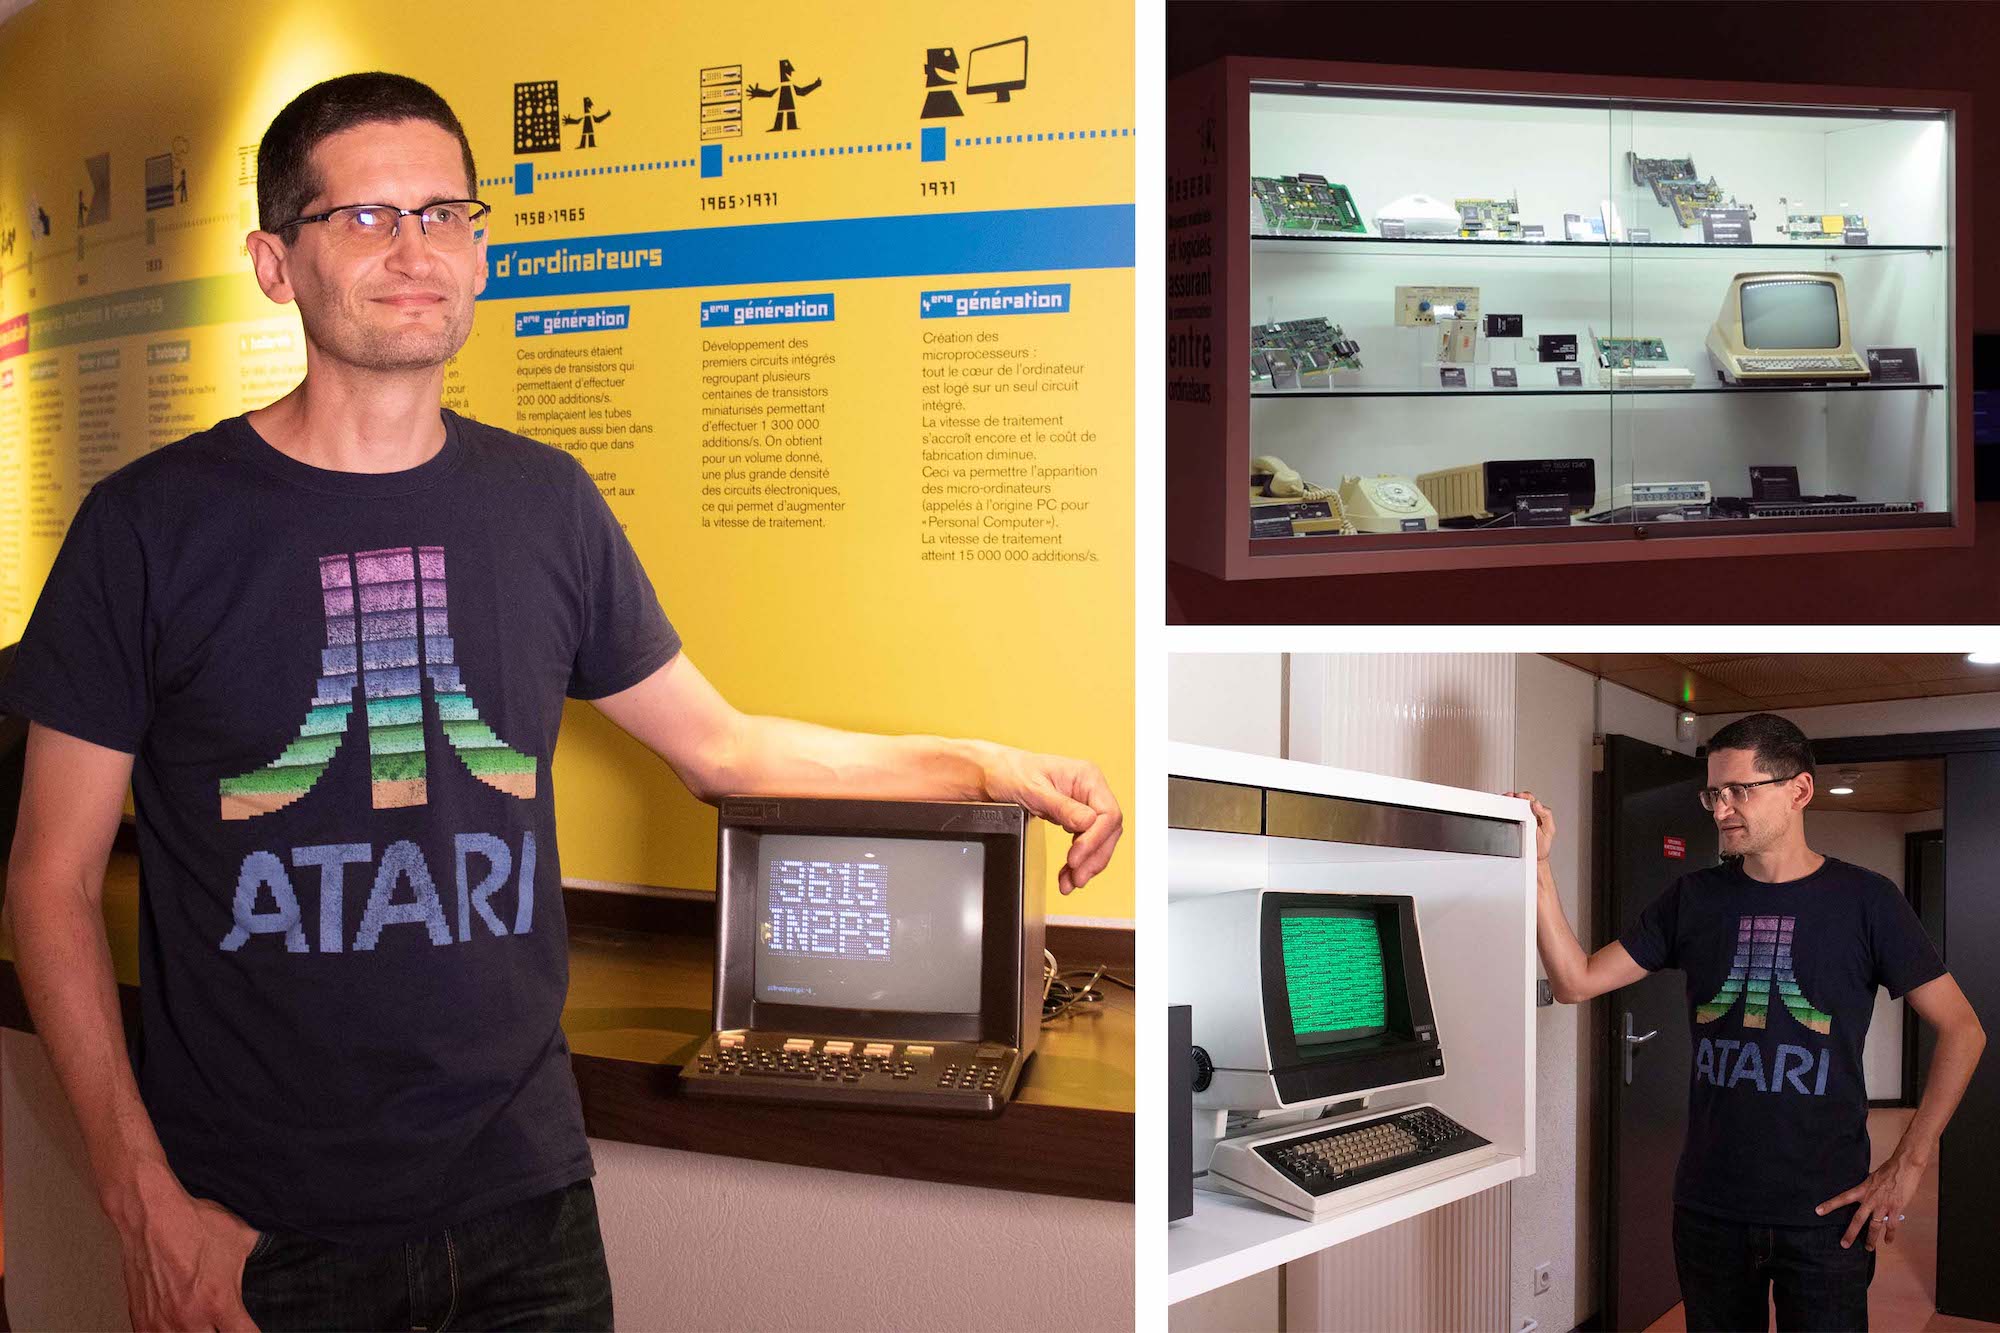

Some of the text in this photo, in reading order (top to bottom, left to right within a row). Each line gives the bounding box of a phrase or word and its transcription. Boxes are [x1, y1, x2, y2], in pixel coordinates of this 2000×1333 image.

[921, 180, 956, 197] 1971
[496, 247, 662, 278] d'ordinateurs
[957, 291, 1062, 315] génération
[734, 300, 828, 324] génération
[544, 311, 624, 333] génération
[923, 331, 998, 344] Création des
[703, 338, 808, 352] Développement des
[1168, 324, 1211, 368] entre
[517, 346, 622, 360] Ces ordinateurs étaient
[923, 349, 1028, 362] microprocesseurs
[703, 354, 835, 369] premiers circuits intégrés
[517, 362, 634, 377] équipés de transistors qui
[923, 367, 944, 377] tout
[949, 367, 958, 377] le
[998, 364, 1012, 375] de
[1017, 364, 1083, 375] l'ordinateur
[517, 378, 625, 392] permettaient d'effectuer
[703, 372, 810, 386] regroupant plusieurs
[703, 387, 828, 400] centaines de transistors
[923, 381, 1079, 396] est logé sur un seul circuit
[517, 393, 611, 405] 200 000 additions/s.
[703, 404, 825, 415] miniaturisés permettant
[923, 400, 965, 413] intégré.
[517, 409, 631, 421] Ils remplaçaient les tubes
[923, 415, 1063, 427] La vitesse de traitement
[579, 424, 603, 435] aussi
[606, 424, 626, 434] bien
[629, 423, 653, 433] dans
[703, 419, 819, 432] d'effectuer 1 300 000
[703, 435, 822, 448] additions/s. On obtient
[975, 433, 1016, 443] encore
[1020, 433, 1031, 443] et
[1036, 431, 1046, 443] le
[1050, 431, 1076, 442] coût
[1081, 430, 1096, 442] de
[565, 440, 587, 450] radio
[590, 442, 607, 451] que
[611, 439, 634, 449] dans
[703, 452, 822, 466] pour un volume donné,
[923, 449, 1036, 461] fabrication diminue.
[703, 468, 829, 482] une plus grande densité
[923, 465, 1097, 479] Ceci va permettre l'apparition
[703, 484, 840, 497] des circuits électroniques,
[922, 483, 1051, 494] des micro-ordinateurs
[703, 501, 845, 514] ce qui permet d'augmenter
[922, 499, 1088, 514] (appelés à l'origine PC pour
[703, 517, 825, 527] la vitesse de traitement.
[922, 532, 1062, 544] La vitesse de traitement
[922, 550, 1099, 562] atteint 15 000 000 additions/s.
[219, 831, 537, 953] ATARI
[1697, 1037, 1830, 1095] ATARI
